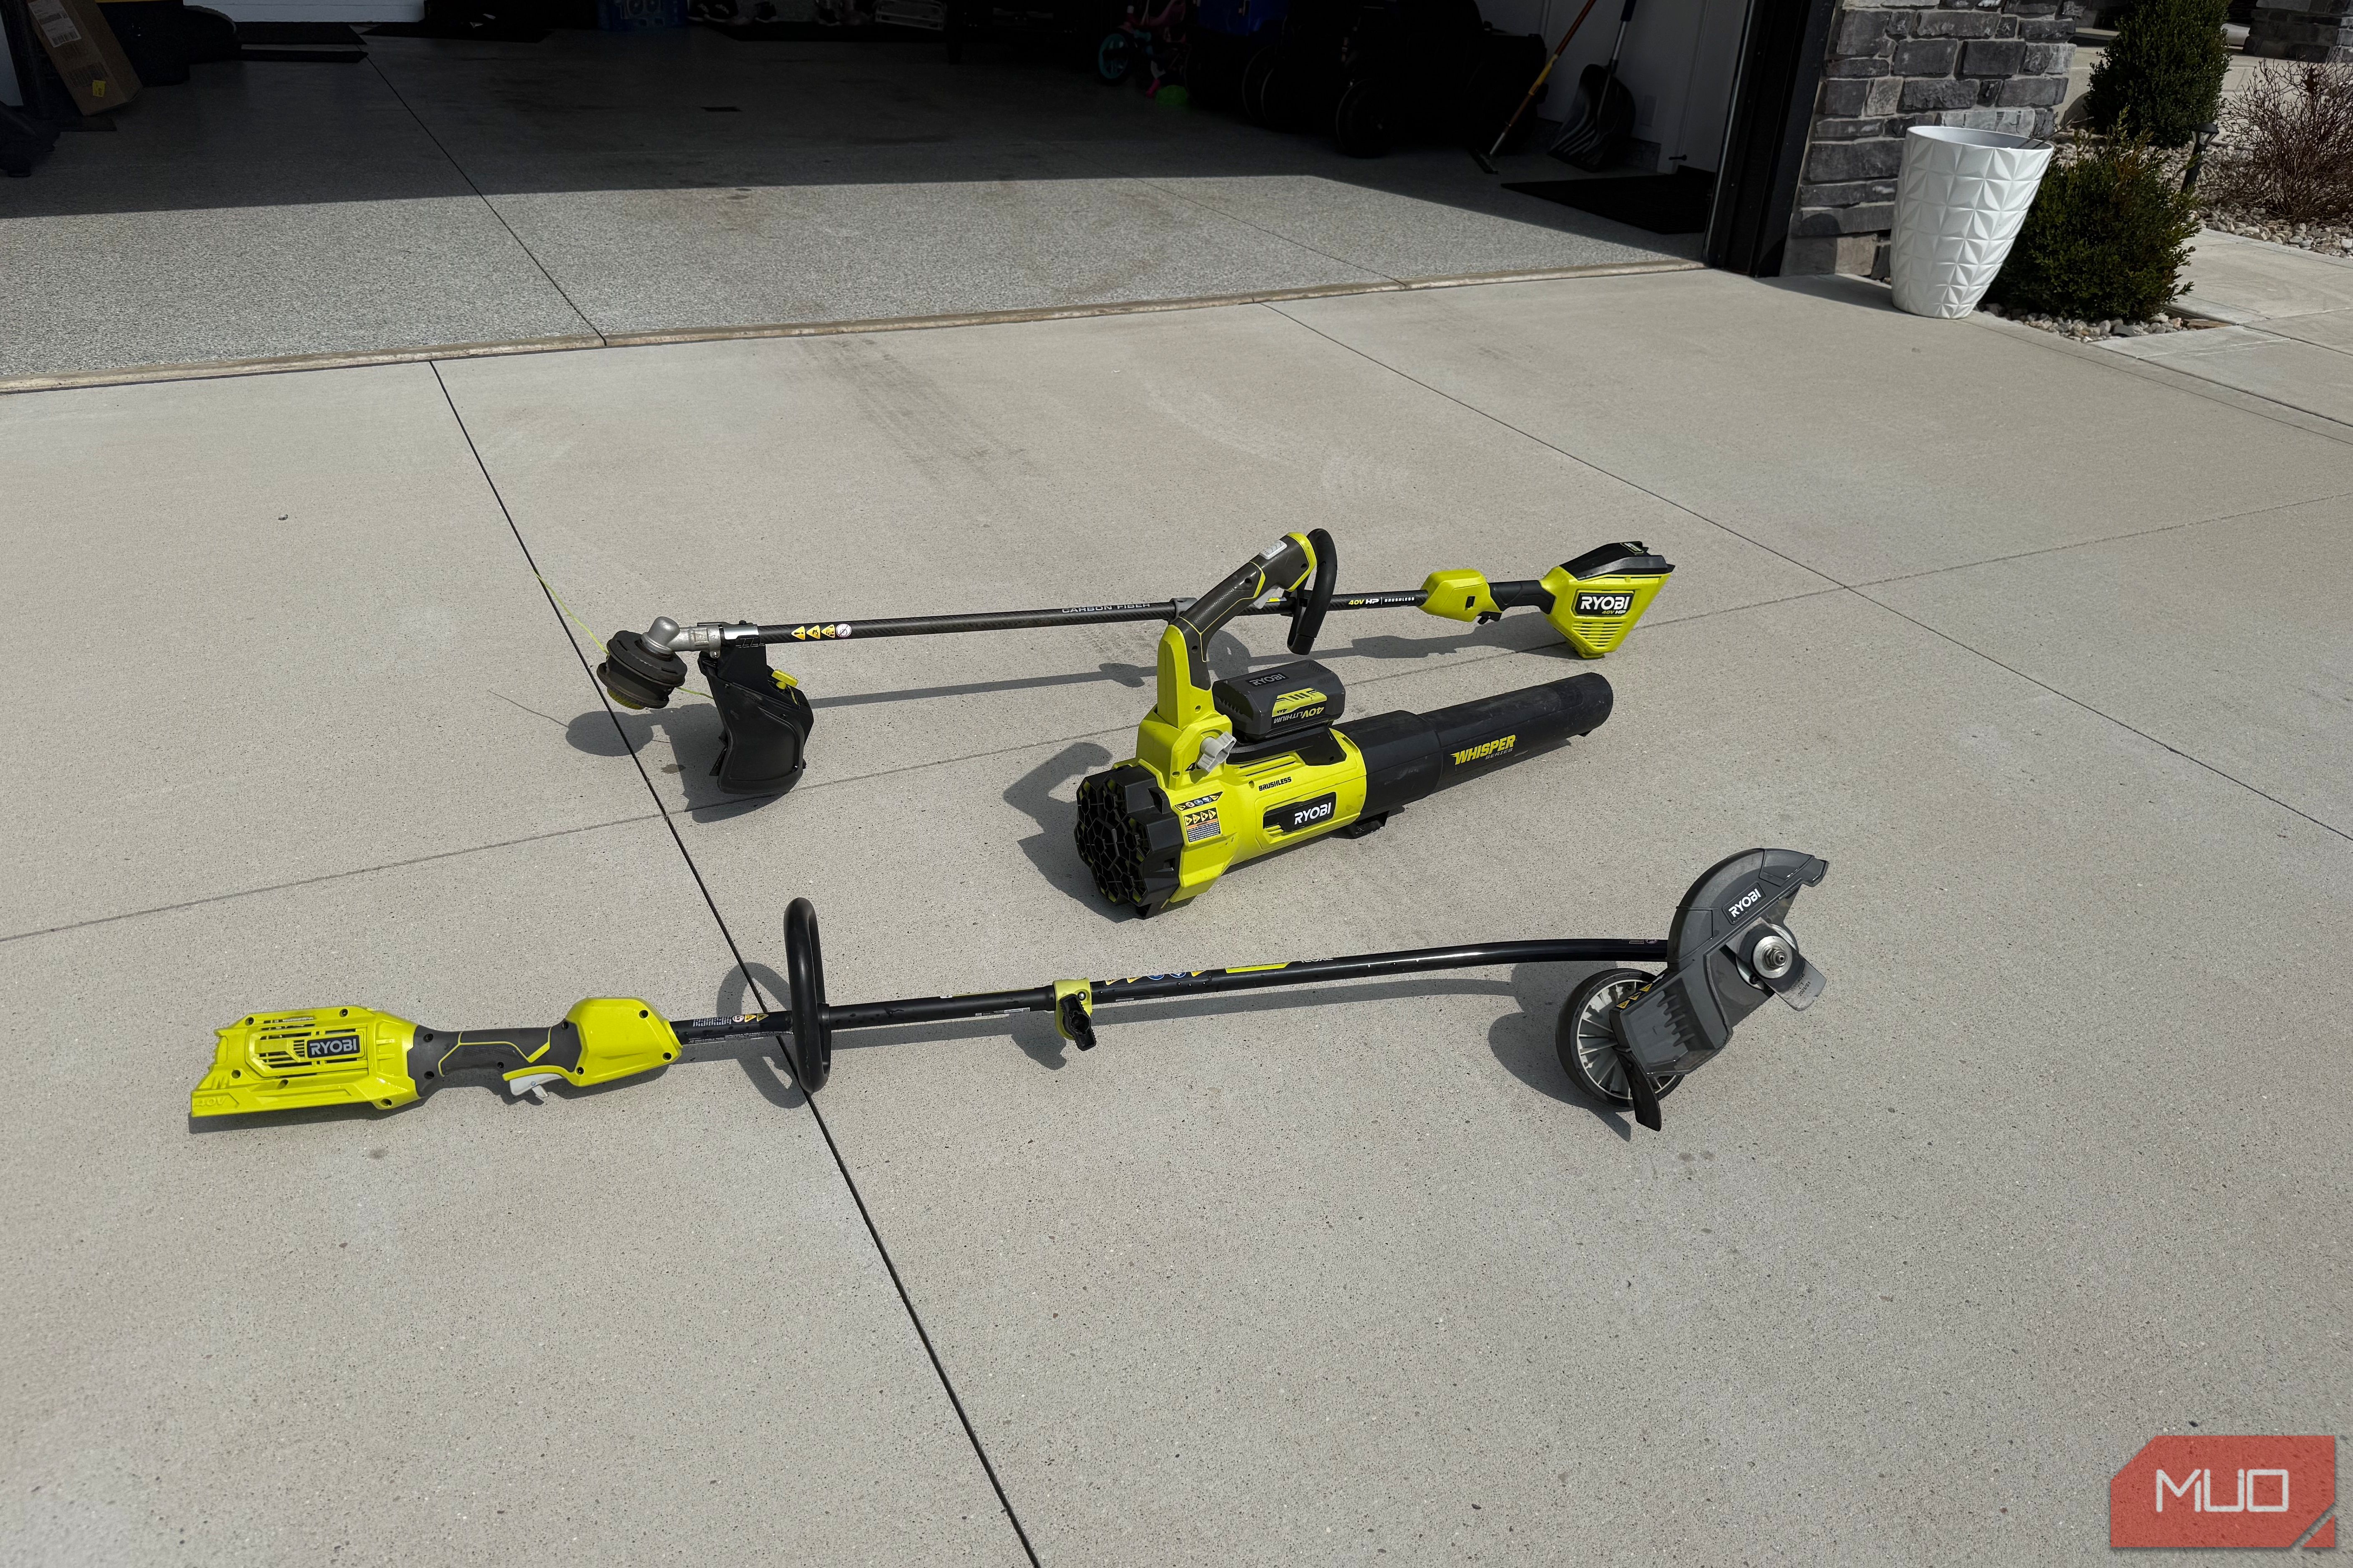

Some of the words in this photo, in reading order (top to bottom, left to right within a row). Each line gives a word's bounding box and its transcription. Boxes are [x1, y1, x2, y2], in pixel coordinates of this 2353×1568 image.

[1580, 596, 1630, 610] RYOBI
[1249, 673, 1286, 686] RYOBI
[1273, 711, 1303, 724] LITHIUM
[1301, 706, 1324, 719] 40V
[1450, 734, 1516, 765] WHISPER
[1485, 748, 1513, 760] SERIES
[1258, 776, 1292, 791] BRUSHLESS
[1294, 802, 1331, 825] RYOBI
[1728, 888, 1762, 917] RYOBI
[310, 1038, 357, 1055] RYOBI
[196, 1097, 227, 1107] 40V
